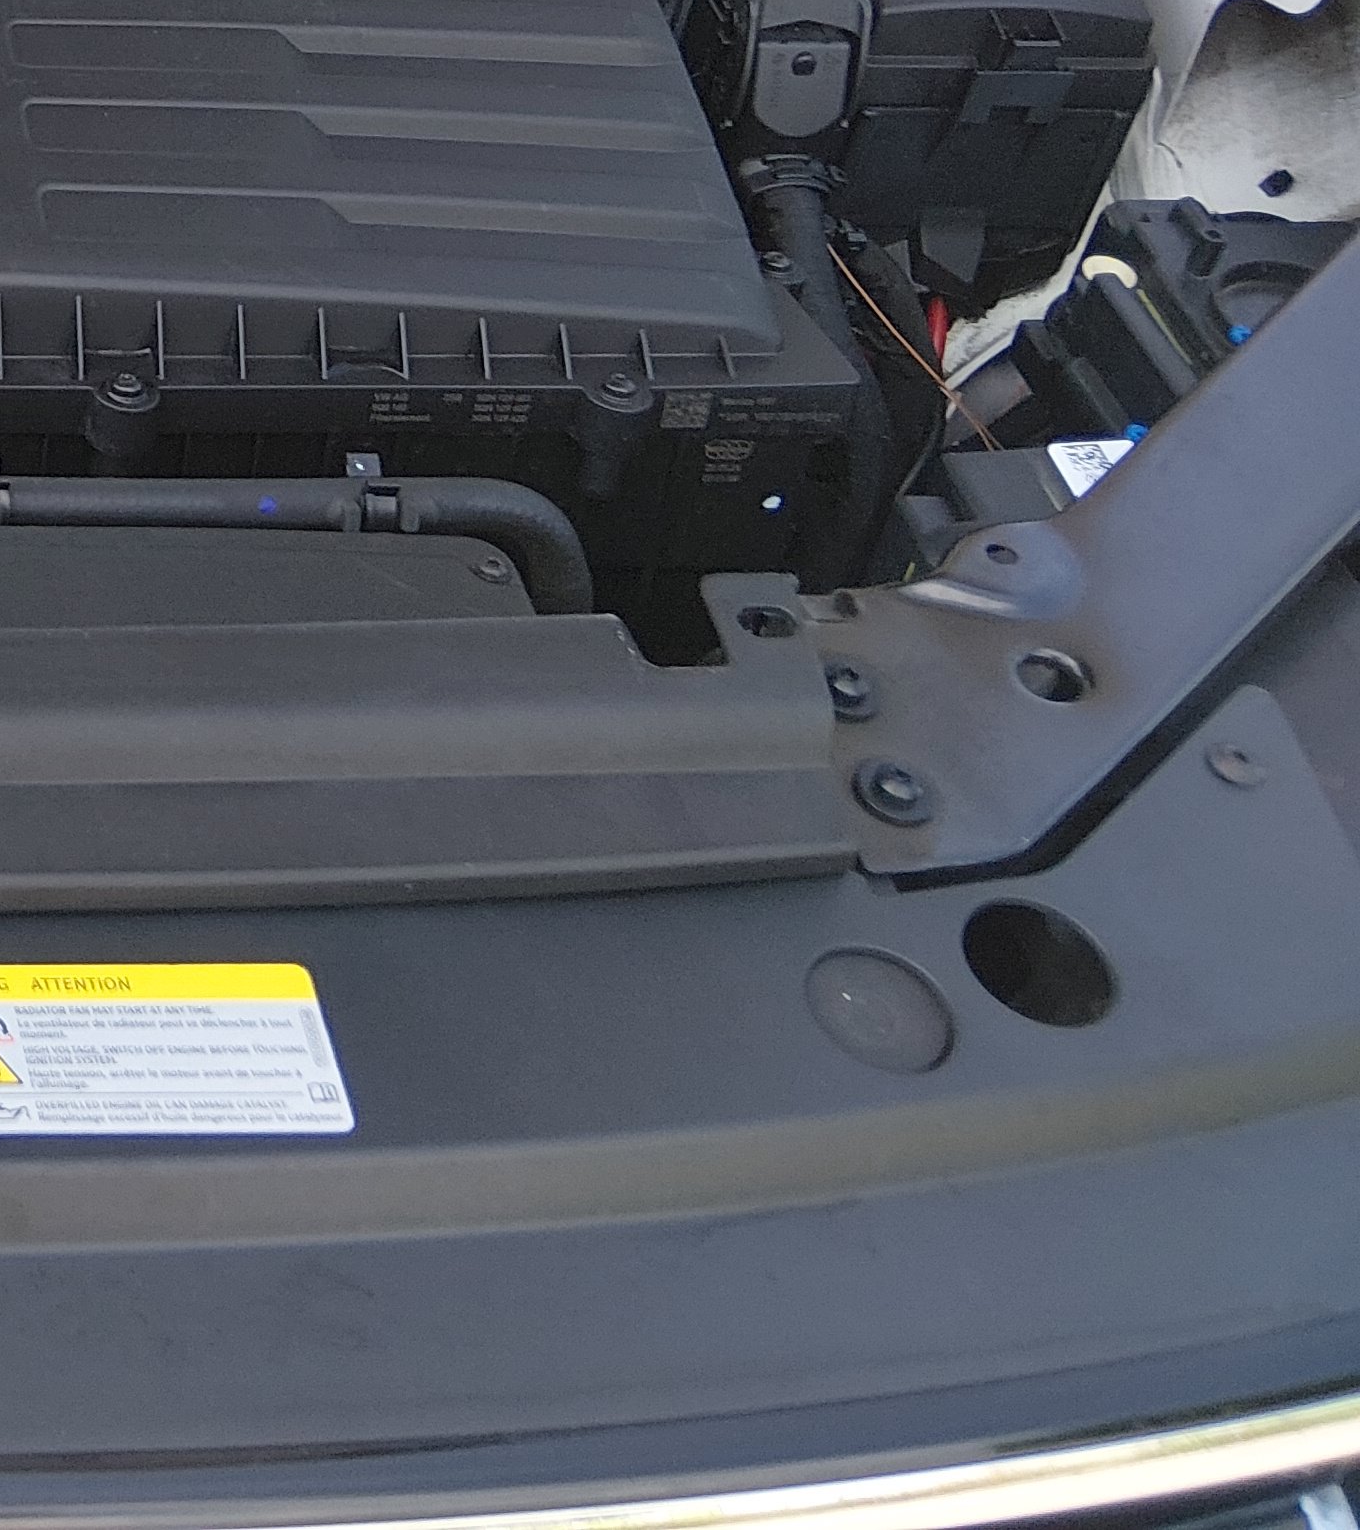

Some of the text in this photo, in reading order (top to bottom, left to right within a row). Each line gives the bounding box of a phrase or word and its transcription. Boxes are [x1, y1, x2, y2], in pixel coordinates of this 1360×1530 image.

[31, 976, 131, 992] ATTENTION
[14, 1005, 67, 1015] RADIATOR
[68, 1005, 91, 1015] FAN
[92, 1005, 114, 1015] MAY
[116, 1005, 147, 1015] START
[149, 1005, 162, 1015] AT
[164, 1005, 185, 1015] ANY
[23, 1045, 49, 1055] HIGH
[101, 1045, 143, 1055] SWITCH
[25, 1055, 73, 1065] IGNITION
